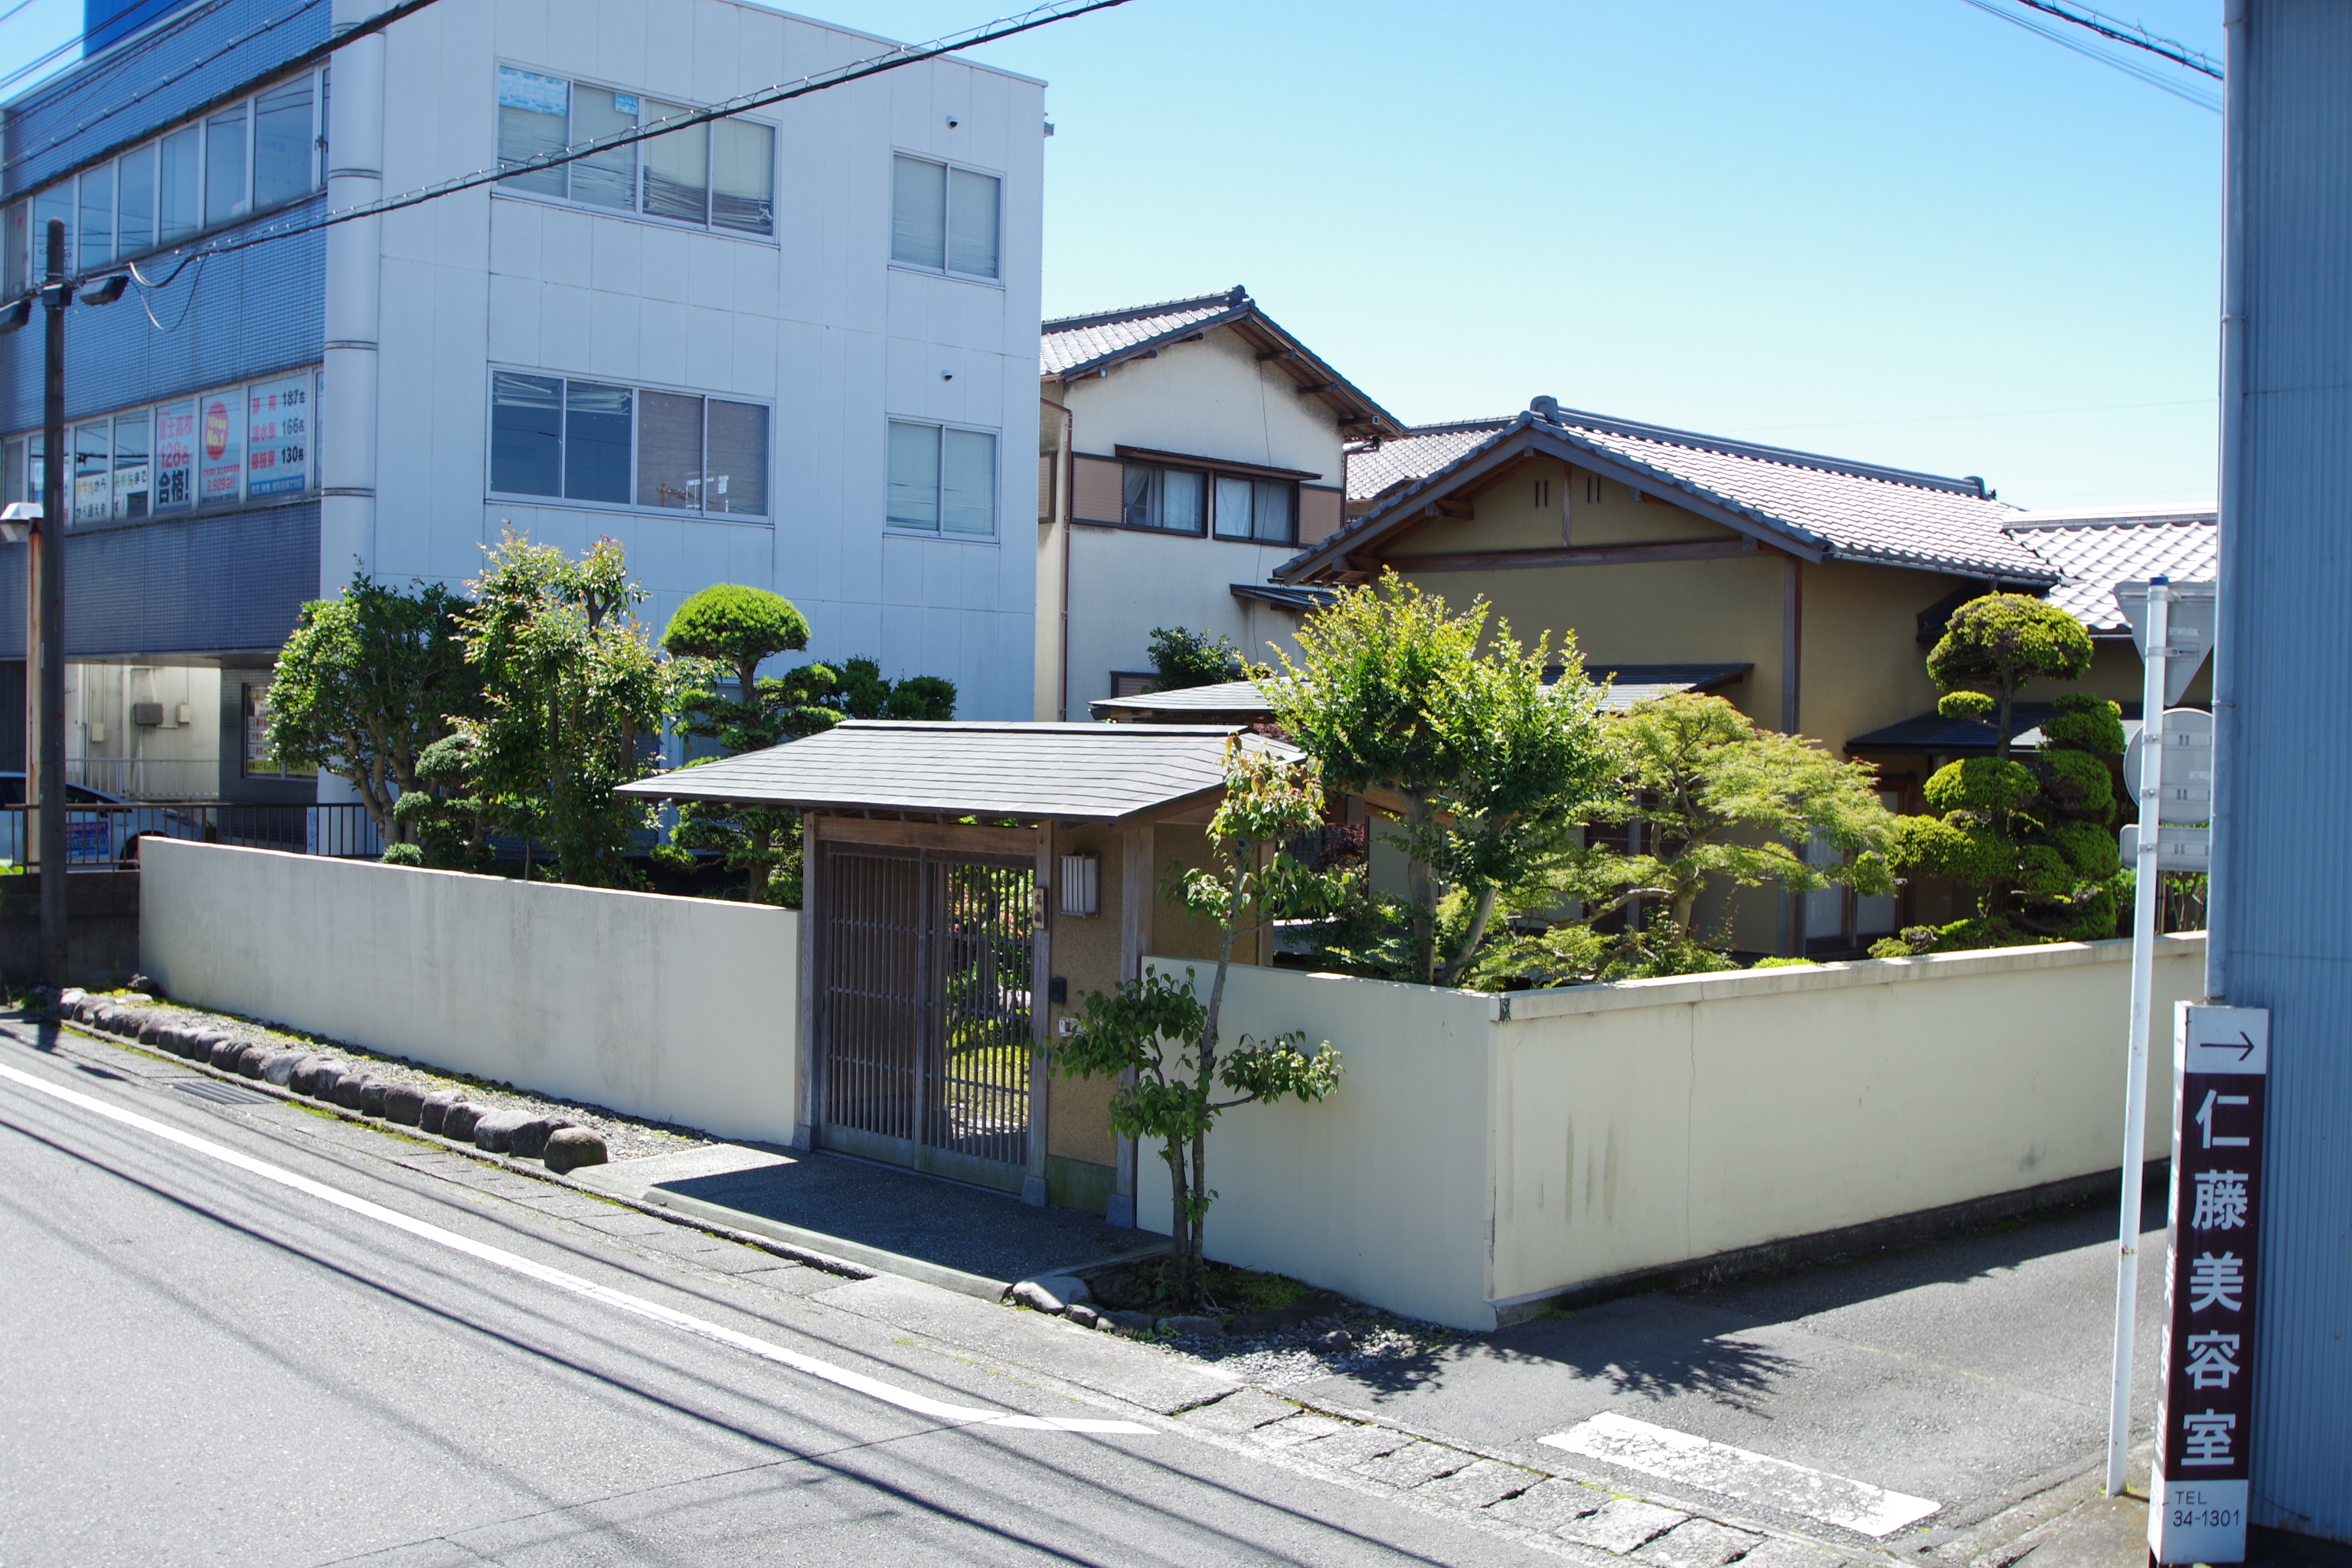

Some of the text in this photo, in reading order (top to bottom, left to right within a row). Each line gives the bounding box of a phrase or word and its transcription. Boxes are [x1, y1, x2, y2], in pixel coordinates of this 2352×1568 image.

[206, 429, 224, 447] No.1
[161, 441, 189, 469] 128名
[2181, 1089, 2249, 1467] 仁藤美容室
[2175, 1491, 2207, 1505] TEL
[2172, 1510, 2239, 1527] 34-1301
